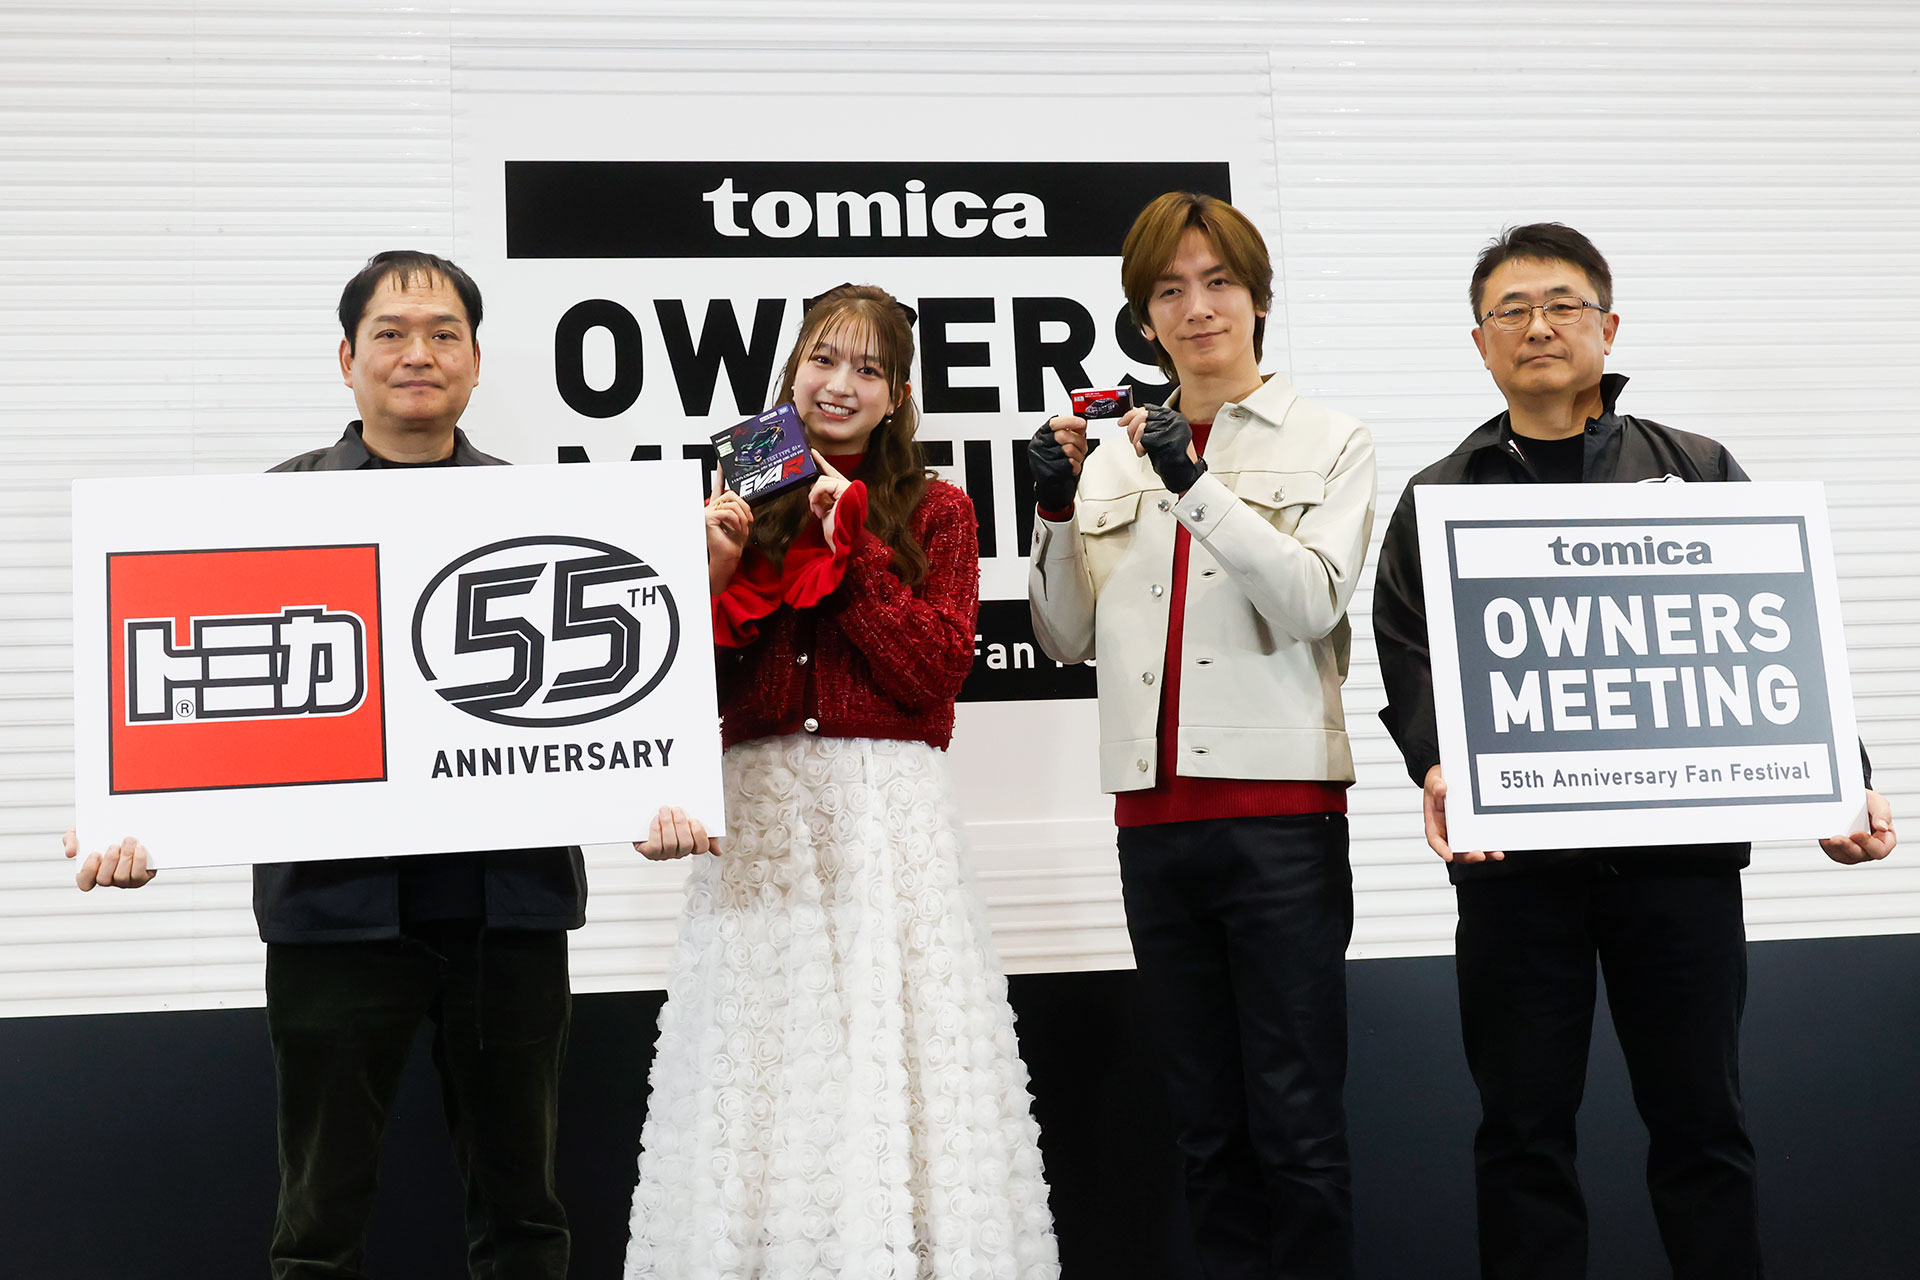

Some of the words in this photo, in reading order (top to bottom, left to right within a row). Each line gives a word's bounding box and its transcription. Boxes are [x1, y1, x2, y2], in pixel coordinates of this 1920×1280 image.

[703, 178, 1047, 239] tomica
[1548, 536, 1712, 566] tomica
[1484, 593, 1791, 658] OWNERS
[1490, 664, 1800, 732] MEETING
[432, 738, 674, 778] ANNIVERSARY
[1501, 769, 1545, 789] 55th
[1553, 767, 1678, 788] Anniversary
[1686, 764, 1722, 783] Fan
[1731, 762, 1811, 781] Festival
